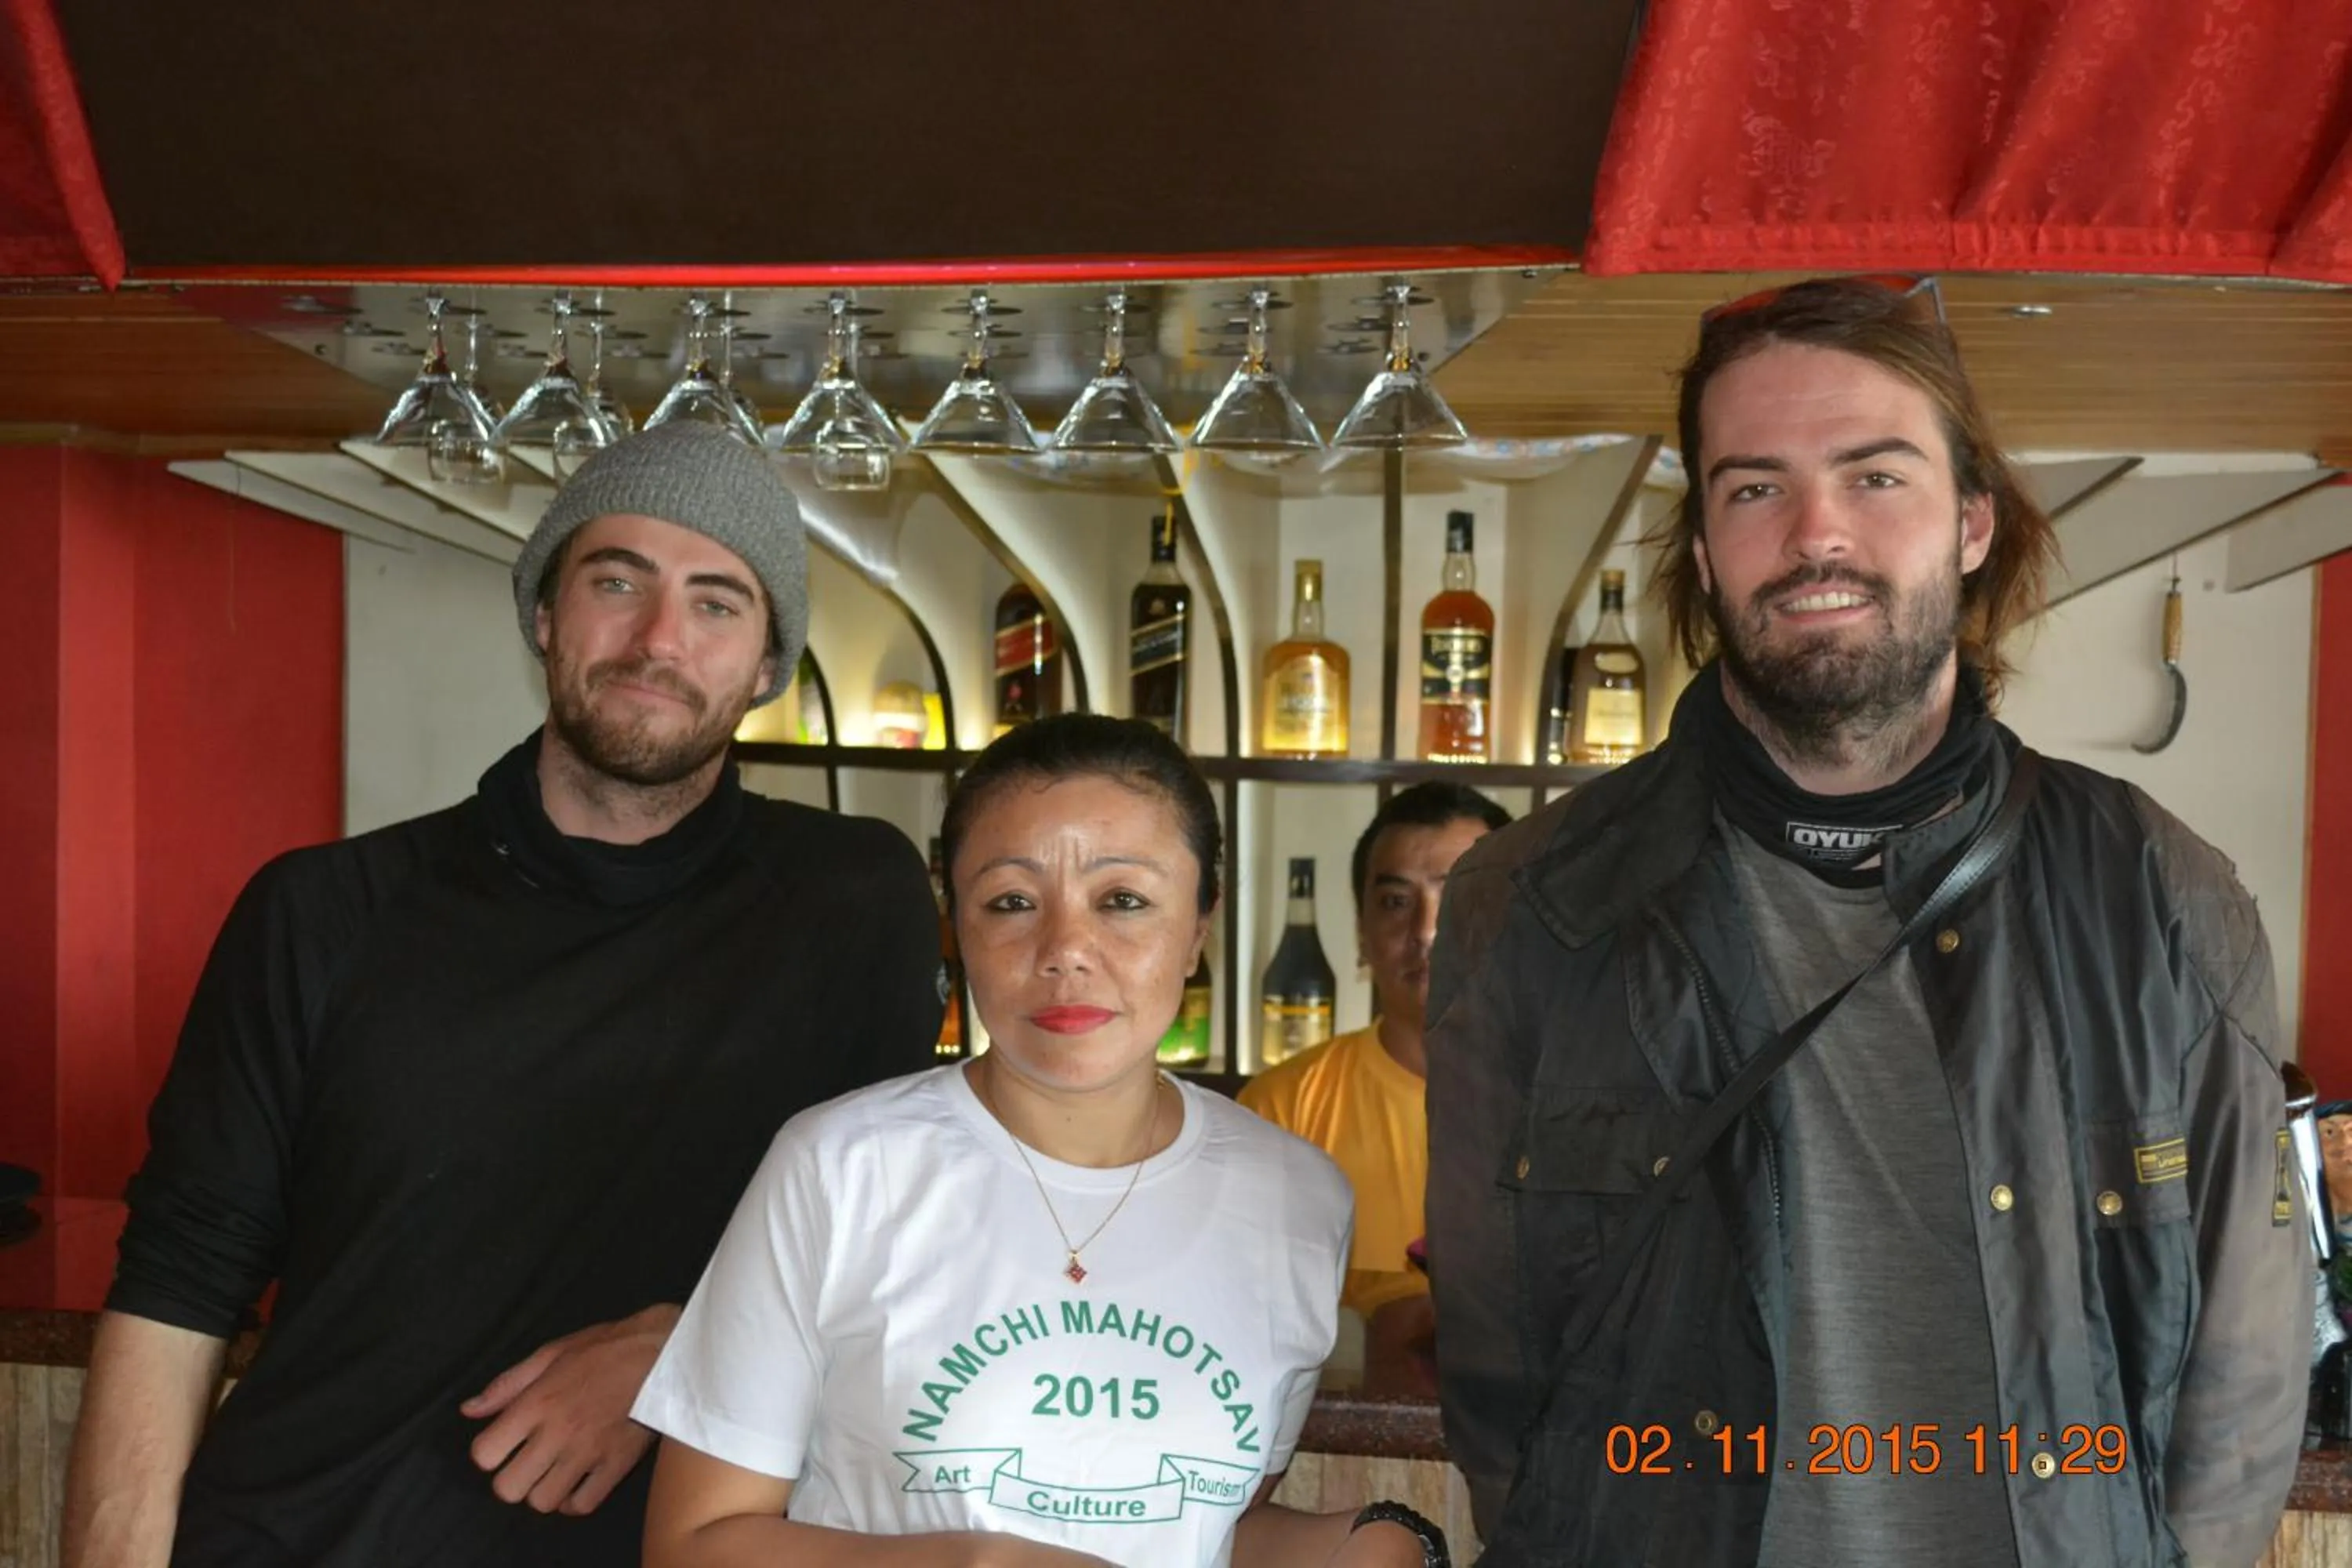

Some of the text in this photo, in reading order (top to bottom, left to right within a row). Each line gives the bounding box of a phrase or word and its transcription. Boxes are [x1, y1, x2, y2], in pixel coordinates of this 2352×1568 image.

[902, 1300, 1261, 1453] NAMCHI MAHOTSAV
[1032, 1374, 1160, 1420] 2015
[935, 1465, 971, 1483] Art
[1189, 1470, 1240, 1497] Tourism
[1027, 1491, 1146, 1516] Culture
